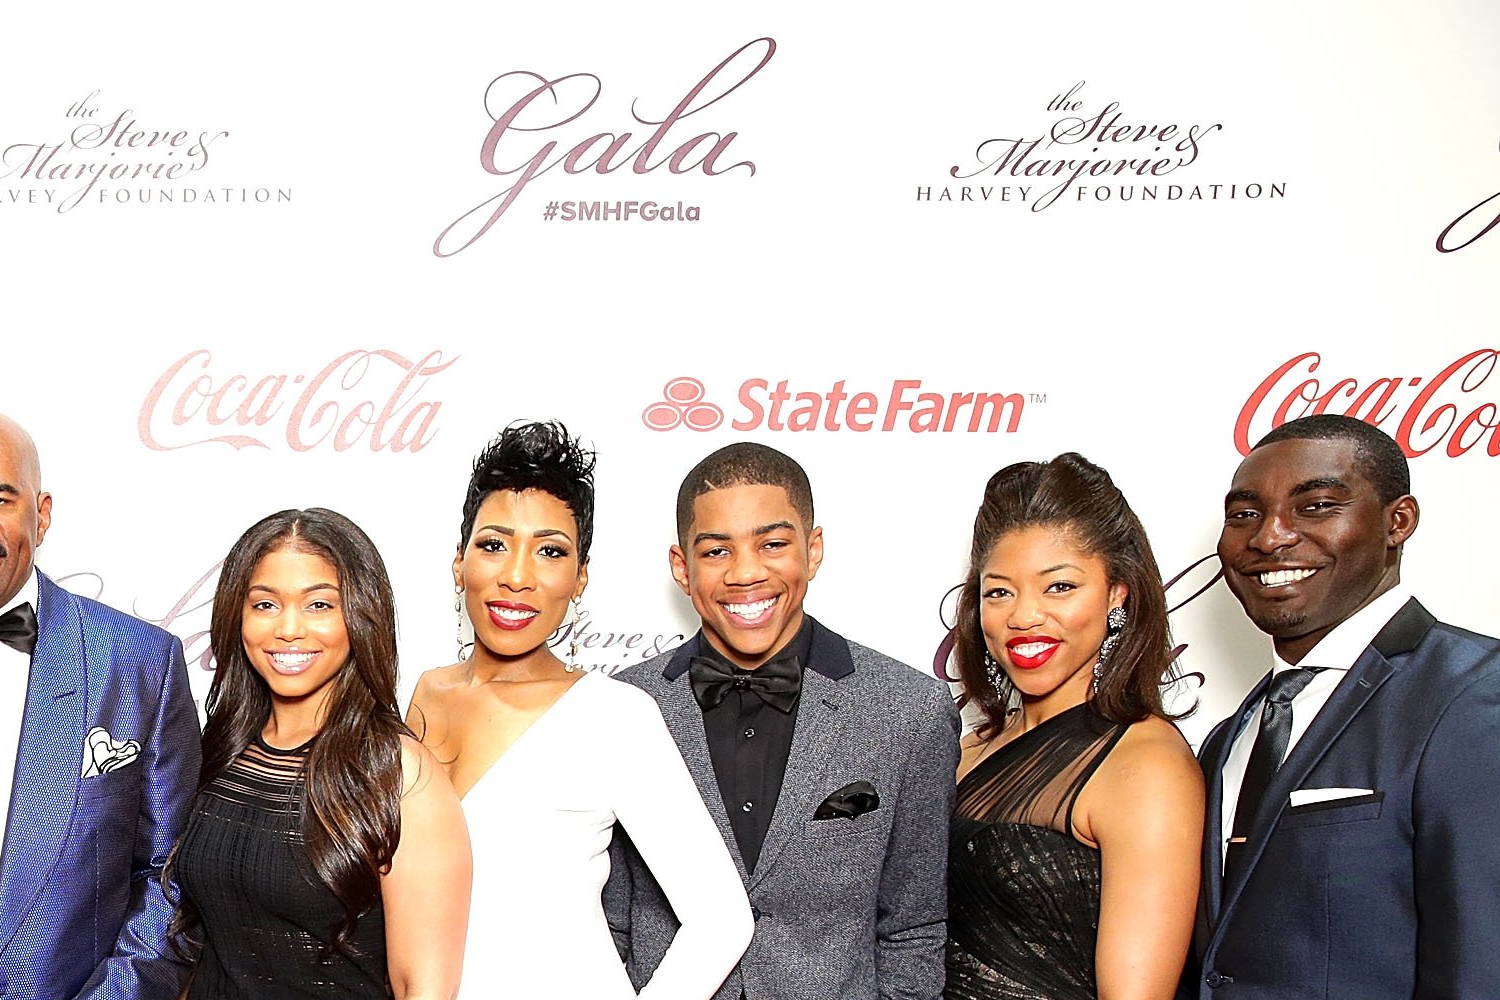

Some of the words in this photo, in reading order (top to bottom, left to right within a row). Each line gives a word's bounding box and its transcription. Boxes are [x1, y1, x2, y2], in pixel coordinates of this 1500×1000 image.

[66, 89, 101, 118] the
[1046, 80, 1086, 112] the
[68, 109, 190, 152] Steve
[1046, 102, 1180, 149] Steve
[433, 37, 778, 258] Gala
[916, 185, 1033, 203] HARVEY
[1076, 182, 1288, 202] FOUNDATION
[950, 136, 1185, 213] Marjorie
[99, 188, 292, 204] FOUNDATION
[543, 201, 701, 222] #SMHFGala
[138, 349, 462, 453] Coca-Cola
